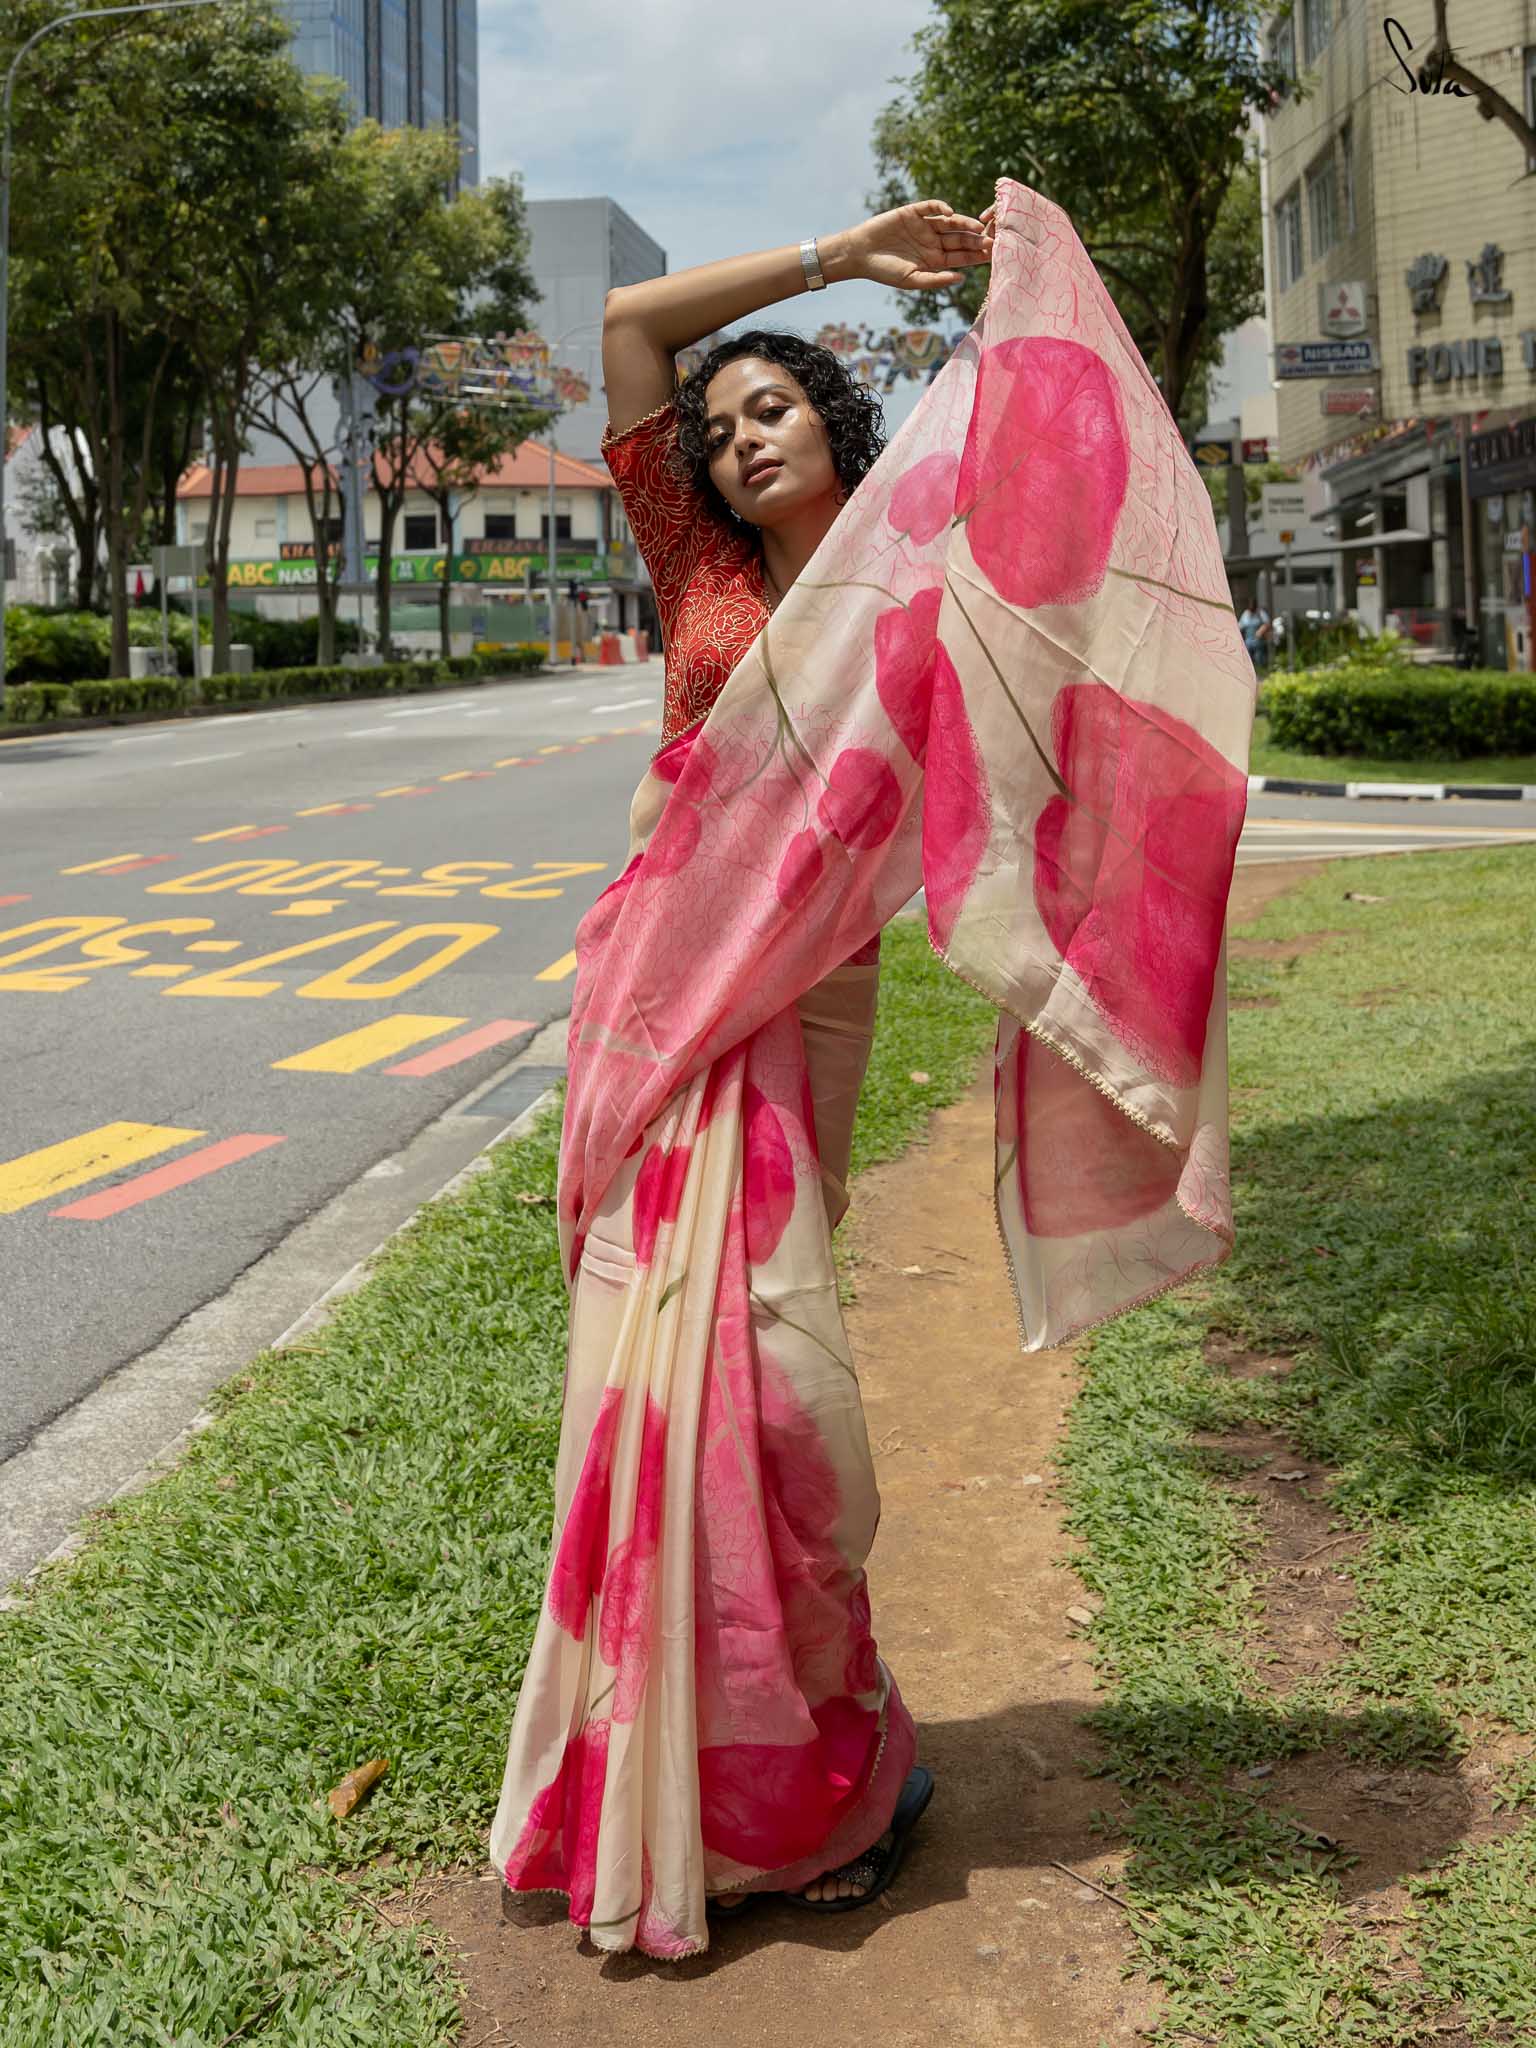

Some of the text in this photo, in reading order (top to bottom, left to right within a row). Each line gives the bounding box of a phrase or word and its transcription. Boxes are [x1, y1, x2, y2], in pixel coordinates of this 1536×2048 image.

[1303, 343, 1367, 361] NISSAN
[227, 562, 273, 585] ABC
[488, 557, 531, 577] ABC
